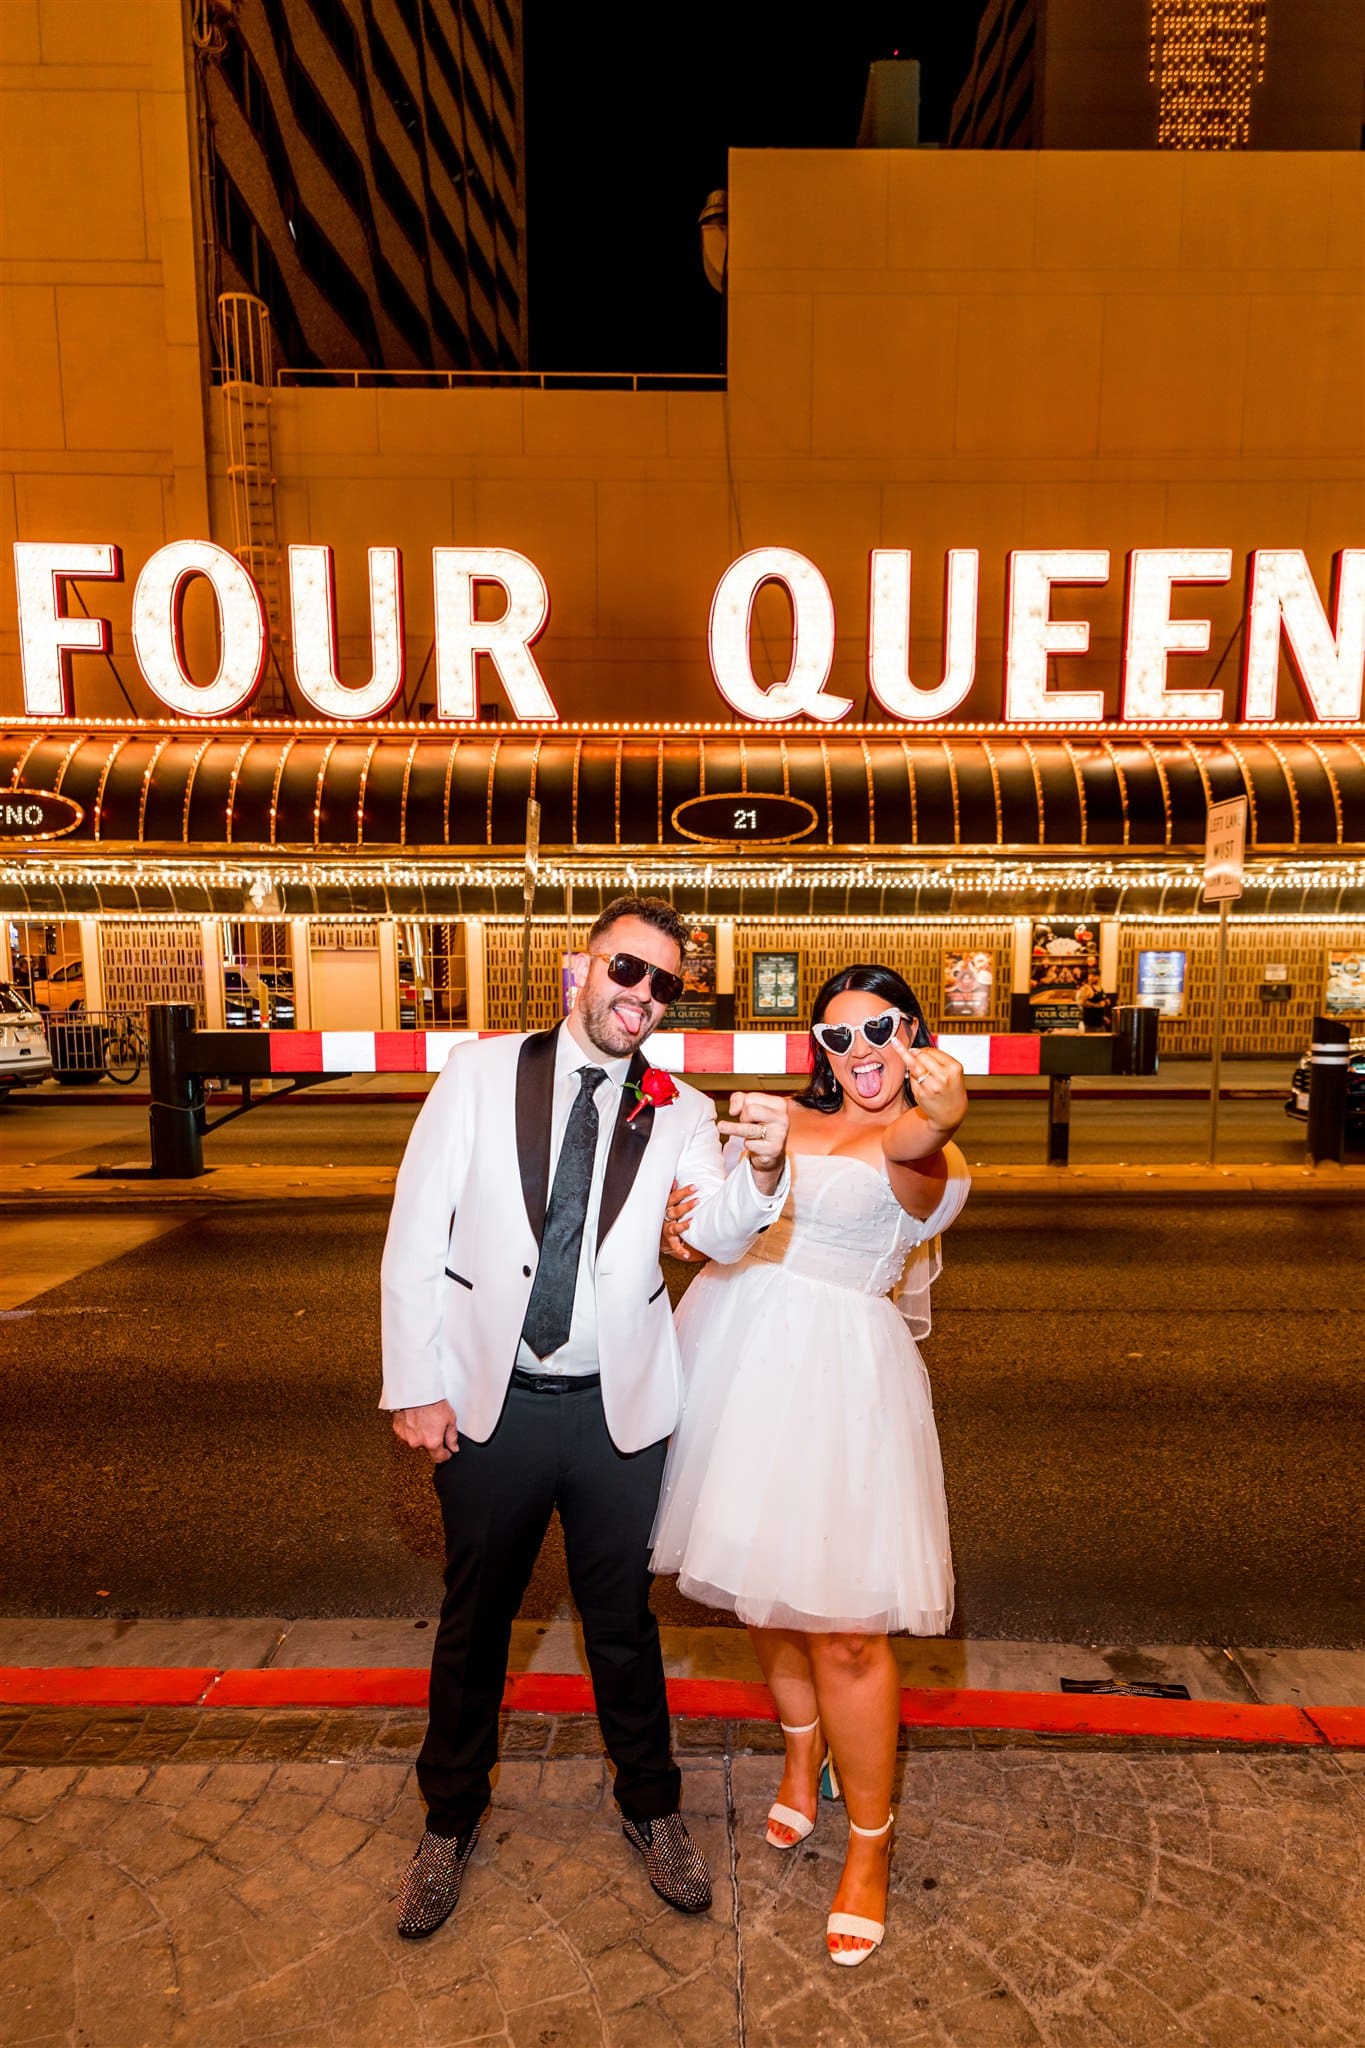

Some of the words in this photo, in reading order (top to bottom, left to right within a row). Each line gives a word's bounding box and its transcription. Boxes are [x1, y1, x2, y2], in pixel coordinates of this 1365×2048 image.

[13, 539, 559, 720] FOUR
[0, 805, 43, 825] NO
[734, 810, 756, 829] 21
